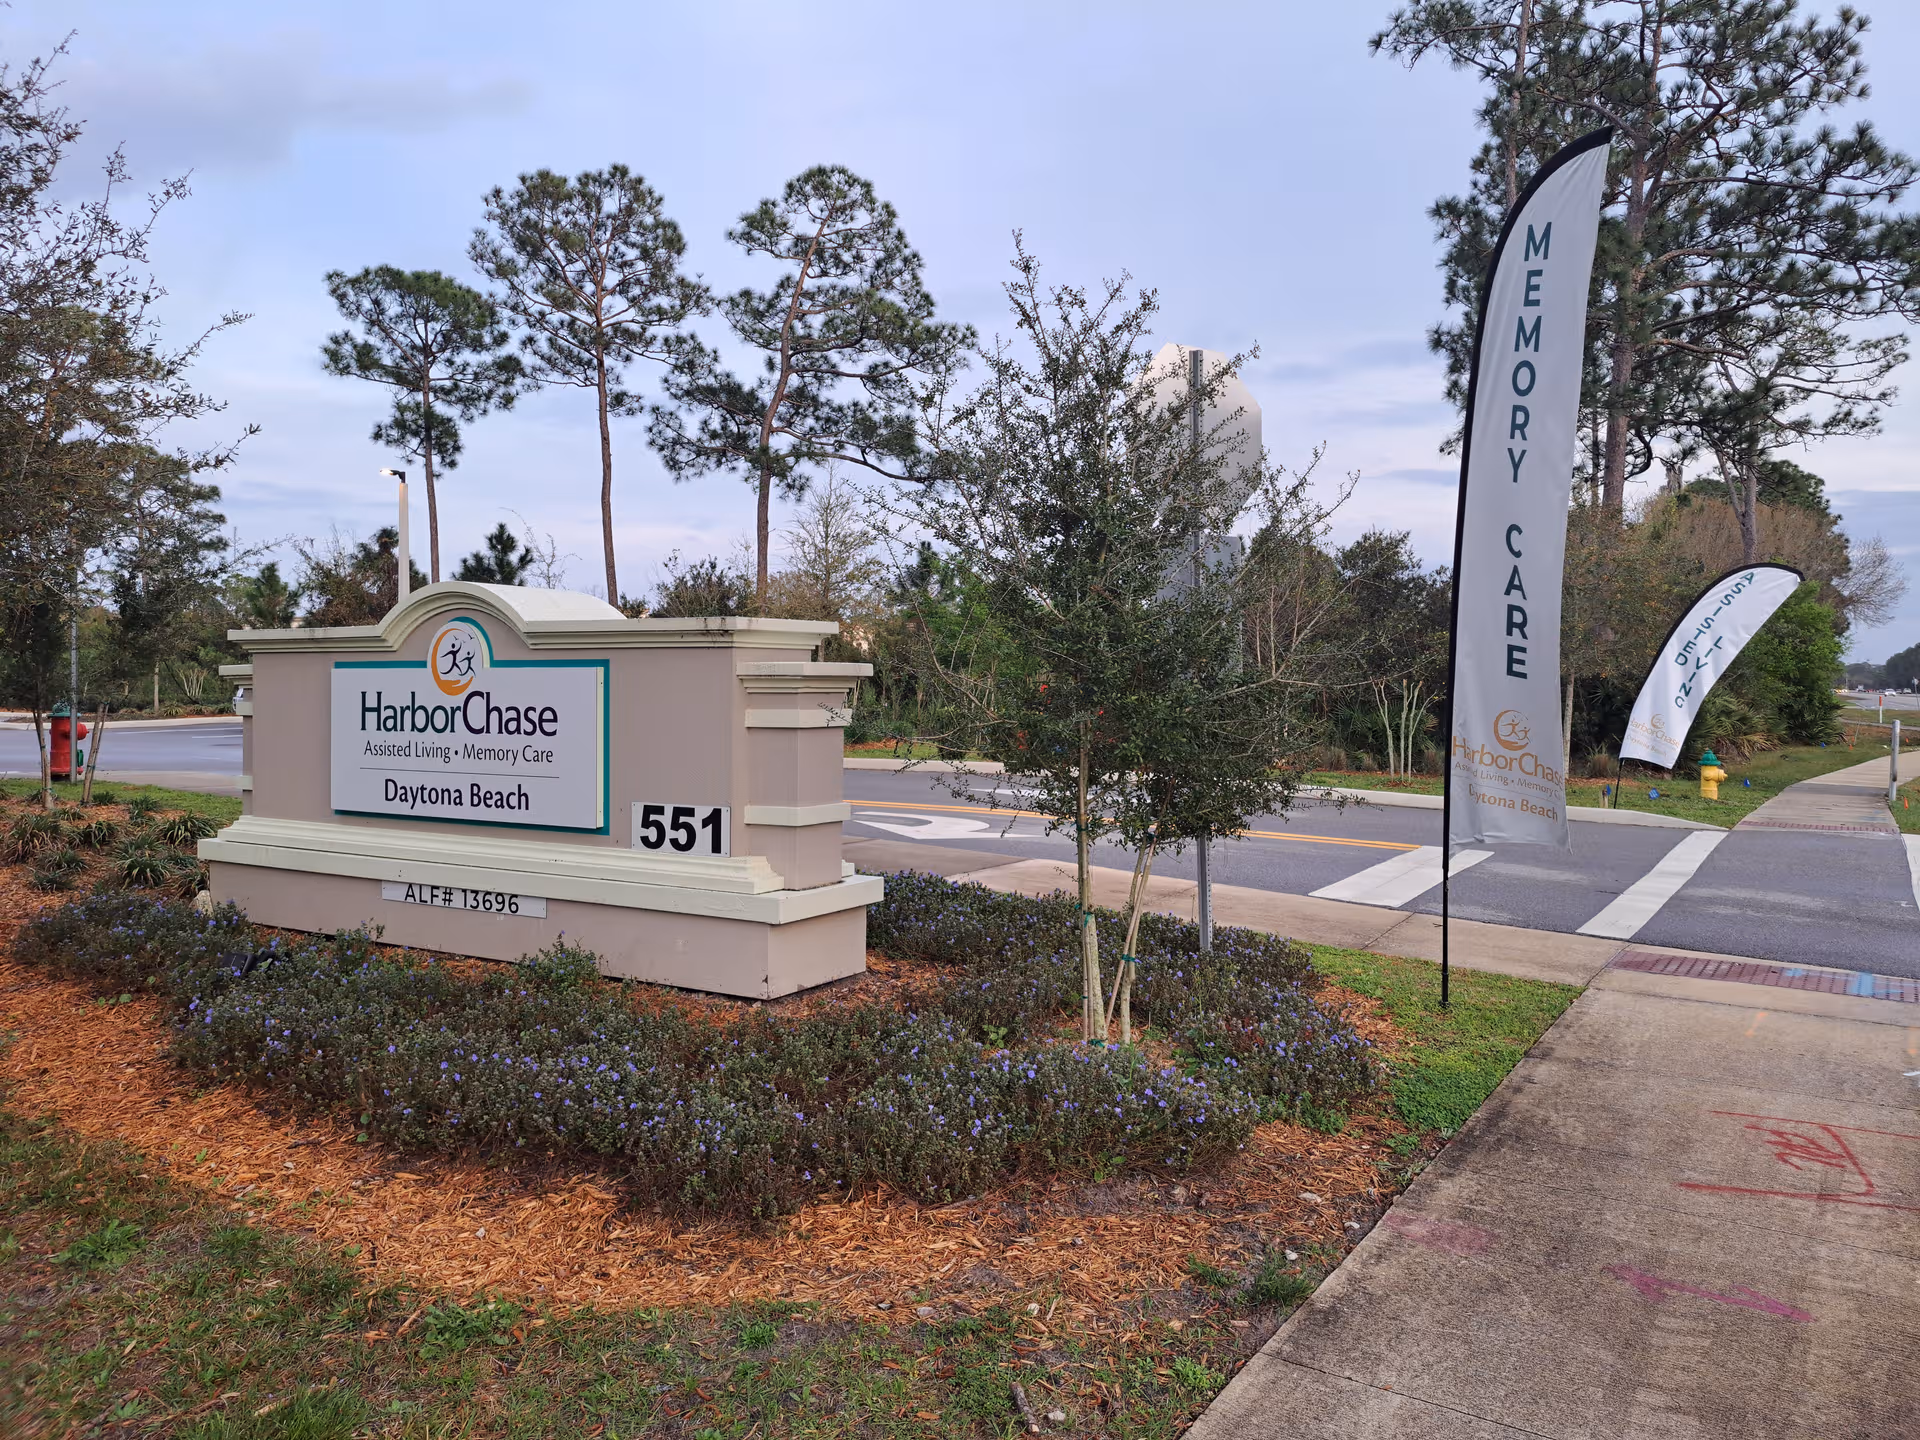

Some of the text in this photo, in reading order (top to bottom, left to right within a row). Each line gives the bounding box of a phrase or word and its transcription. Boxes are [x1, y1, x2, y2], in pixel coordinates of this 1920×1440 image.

[1503, 221, 1552, 680] MEMORY CARE
[1674, 571, 1756, 666] ASSISTED
[1674, 635, 1723, 708] LIVING
[360, 690, 559, 737] HarborChase
[363, 740, 554, 766] Assisted Living Memory Care
[384, 778, 530, 811] Daytona Beach
[1468, 783, 1558, 823] Dytona Beach
[1480, 770, 1509, 787] Living
[1517, 778, 1557, 799] Memory
[639, 804, 722, 854] 551
[404, 883, 520, 914] ALF# 13696
